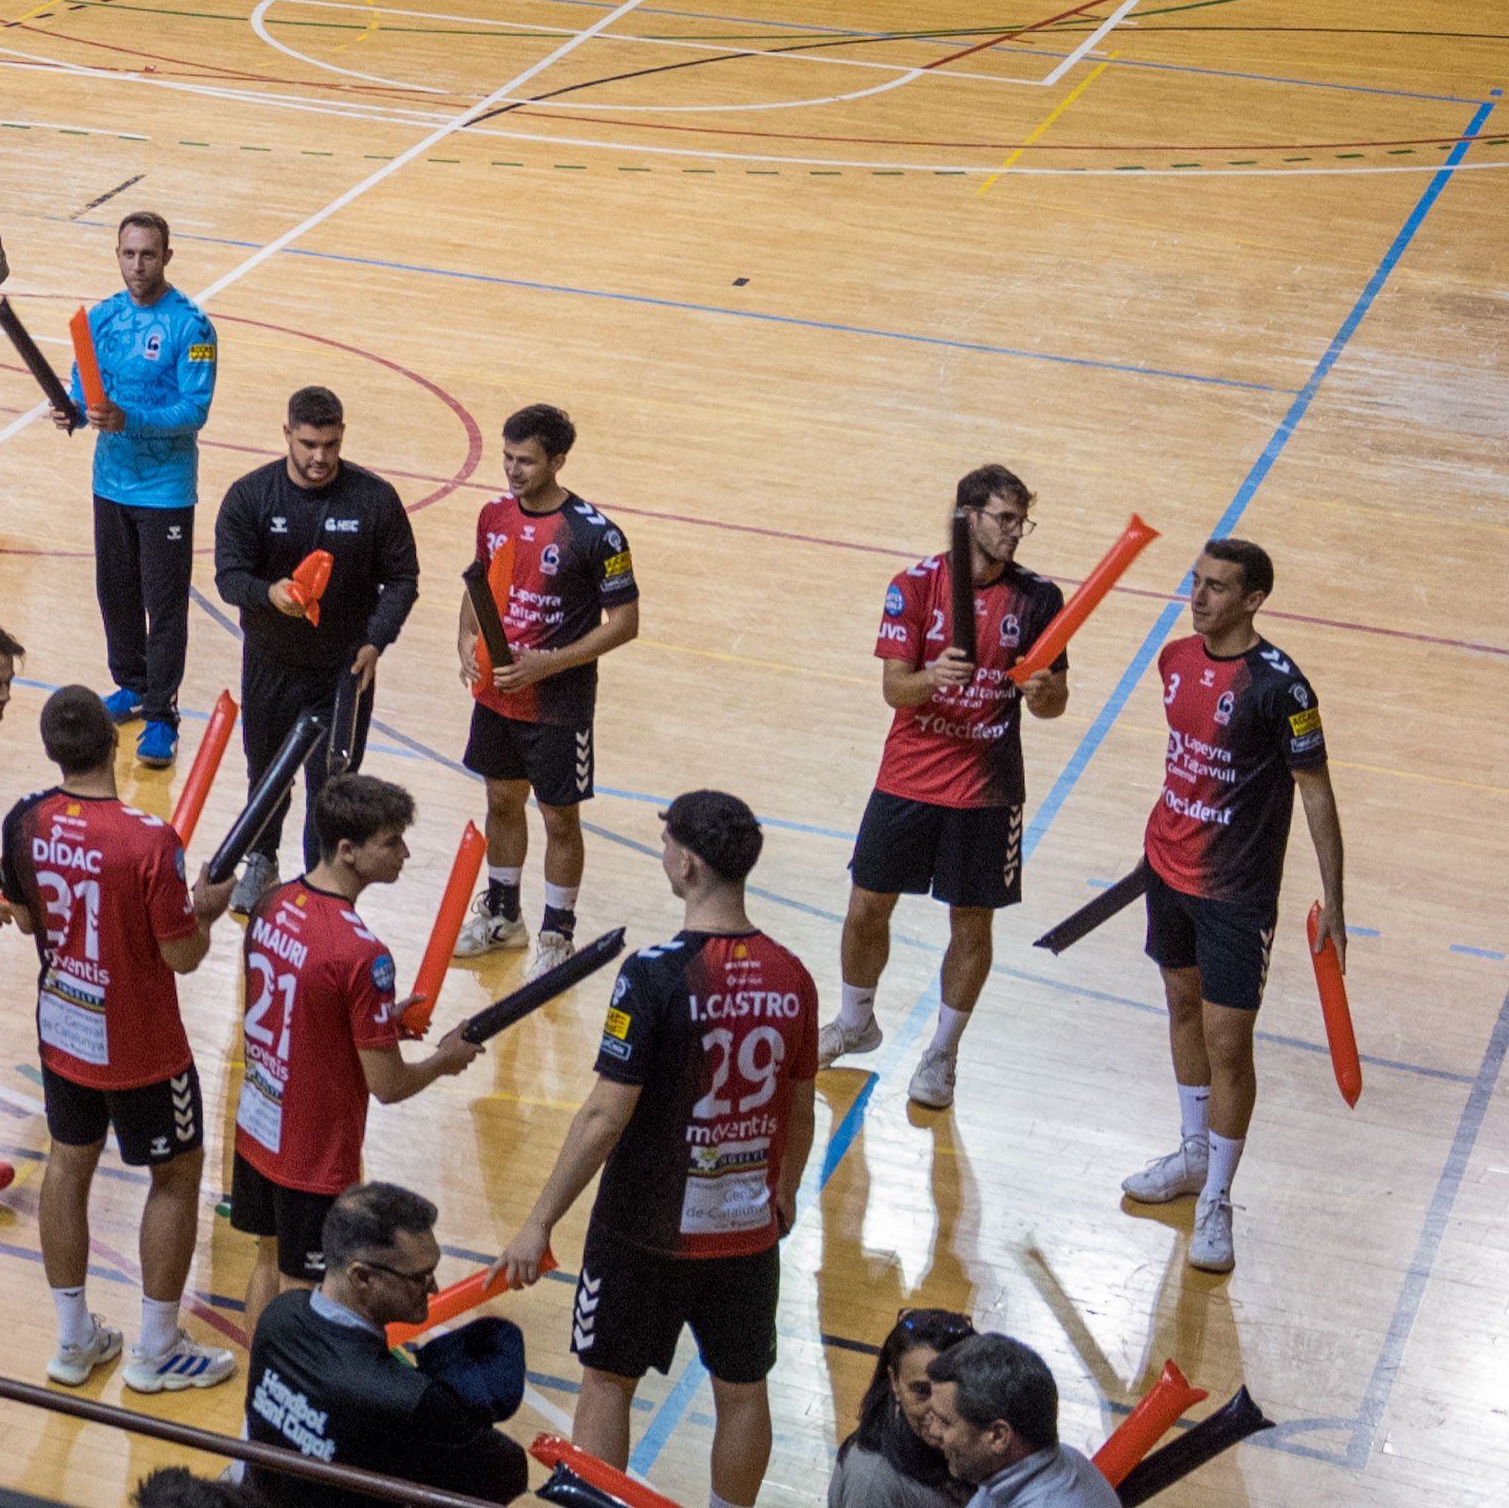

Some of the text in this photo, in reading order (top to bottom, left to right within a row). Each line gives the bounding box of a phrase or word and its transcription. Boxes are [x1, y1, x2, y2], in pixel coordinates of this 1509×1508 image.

[879, 622, 907, 642] JVC
[926, 608, 945, 641] 2
[36, 870, 102, 962] 31
[251, 916, 308, 970] MAURI
[244, 951, 298, 1063] 21
[689, 992, 800, 1021] I.CASTRO
[692, 1026, 785, 1119] 29
